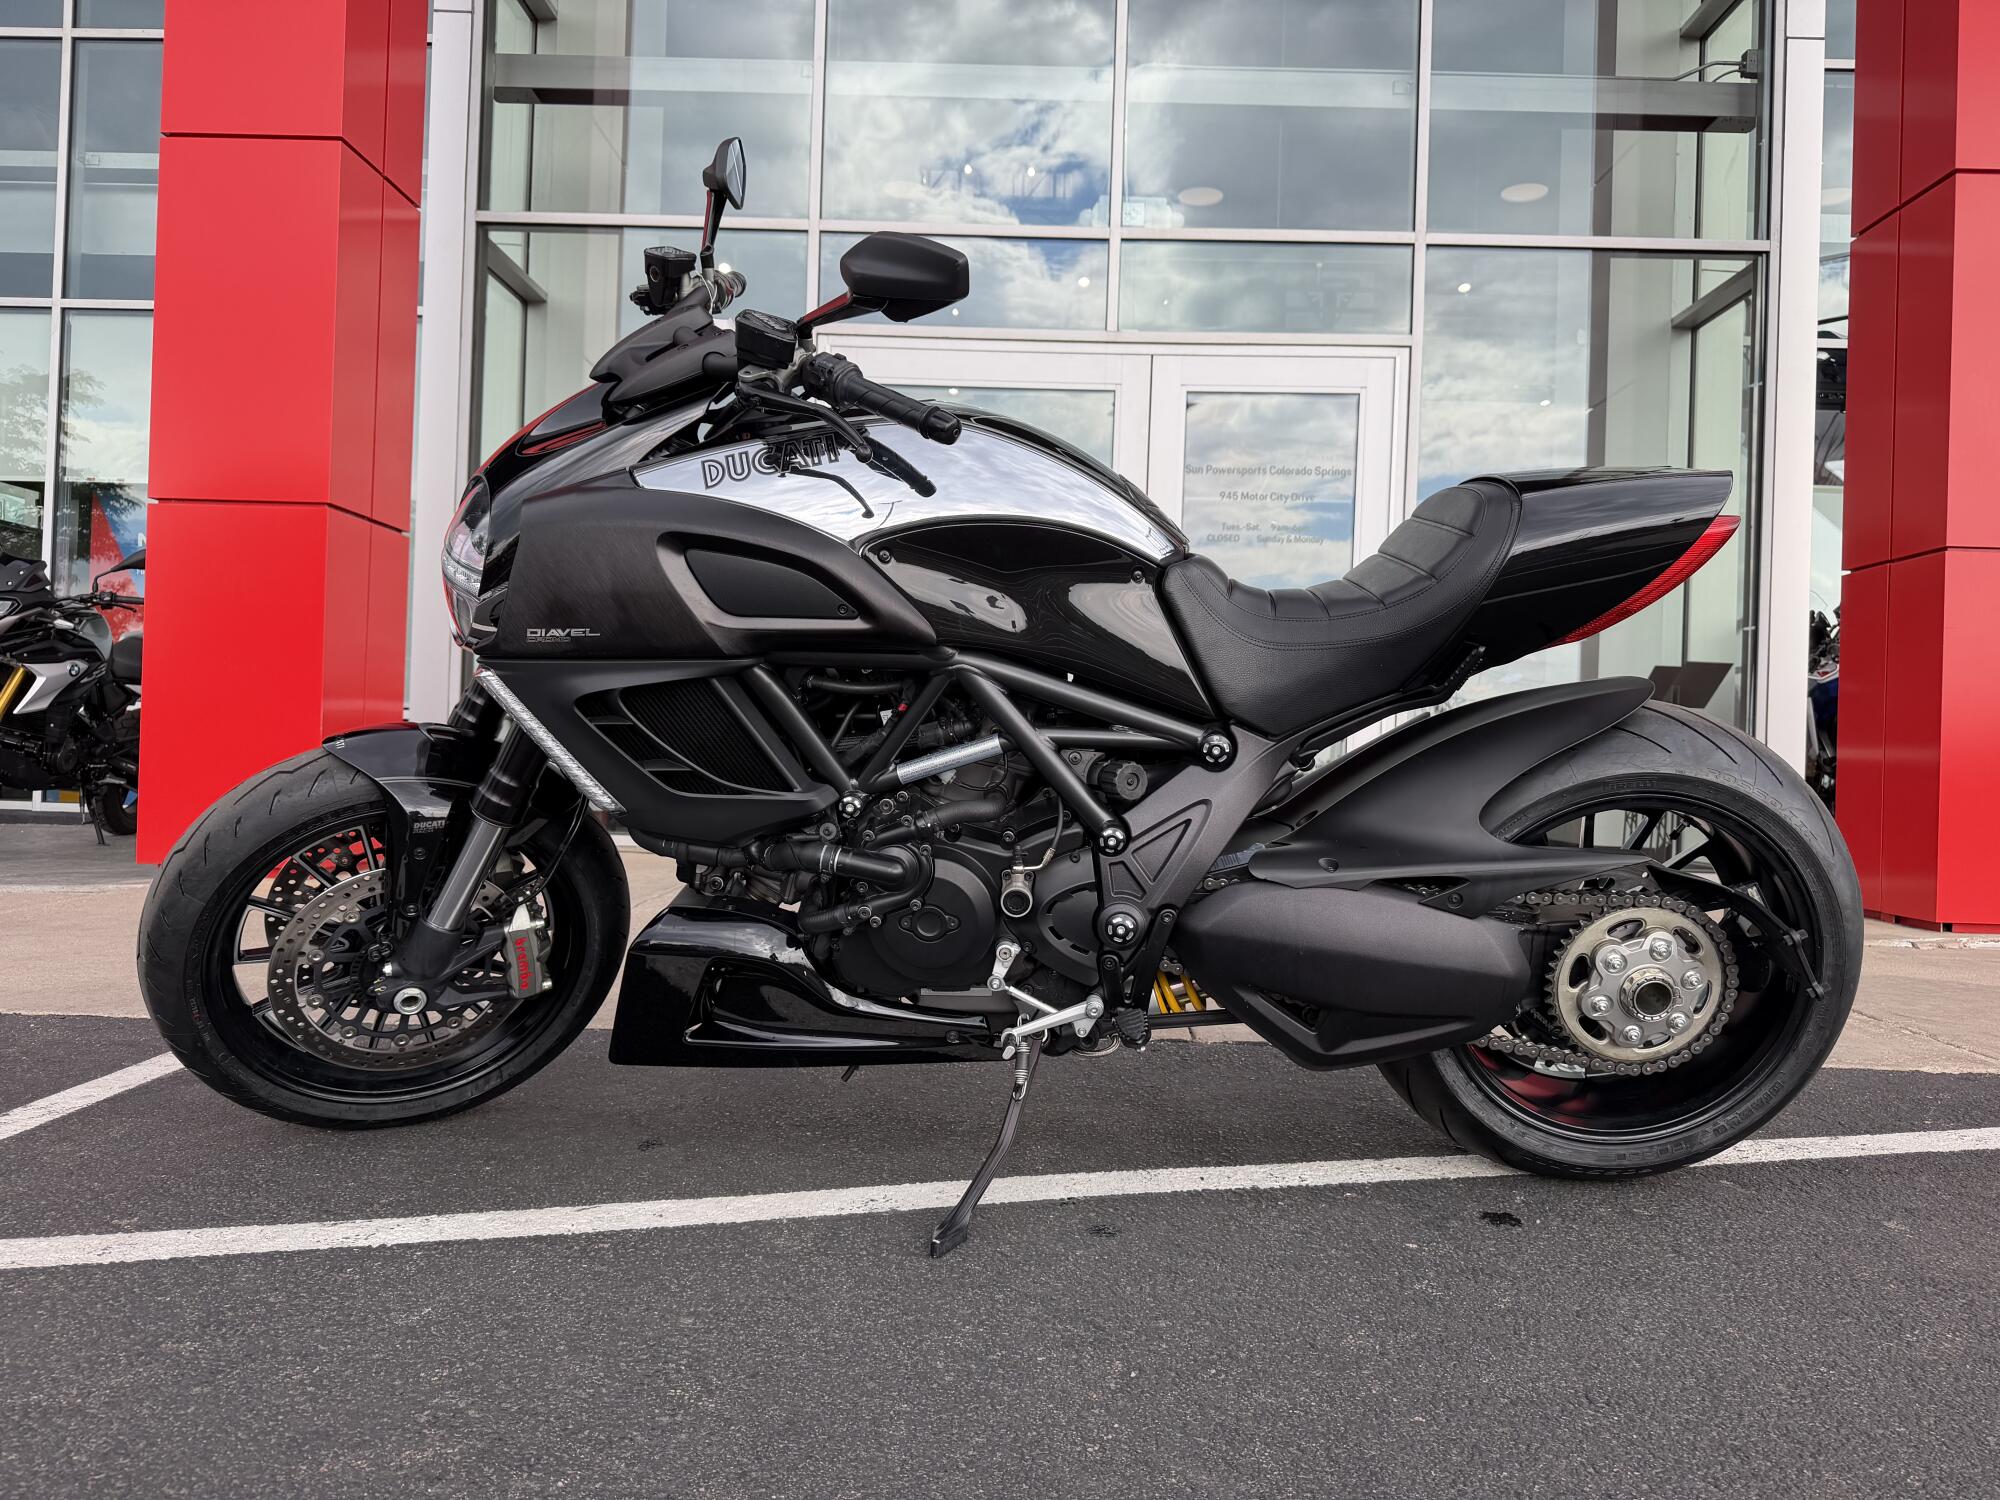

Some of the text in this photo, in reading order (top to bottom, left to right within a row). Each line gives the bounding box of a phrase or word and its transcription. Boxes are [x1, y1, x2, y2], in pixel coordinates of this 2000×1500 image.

[701, 433, 840, 490] DUCATI
[1185, 464, 1352, 478] Sun Powersports Colorado Springs
[1240, 491, 1268, 501] Motor
[1269, 491, 1290, 504] City
[1206, 533, 1240, 543] CLOSED
[526, 628, 600, 637] DIAVEL
[413, 820, 446, 829] DUCATI
[515, 937, 535, 990] brembo
